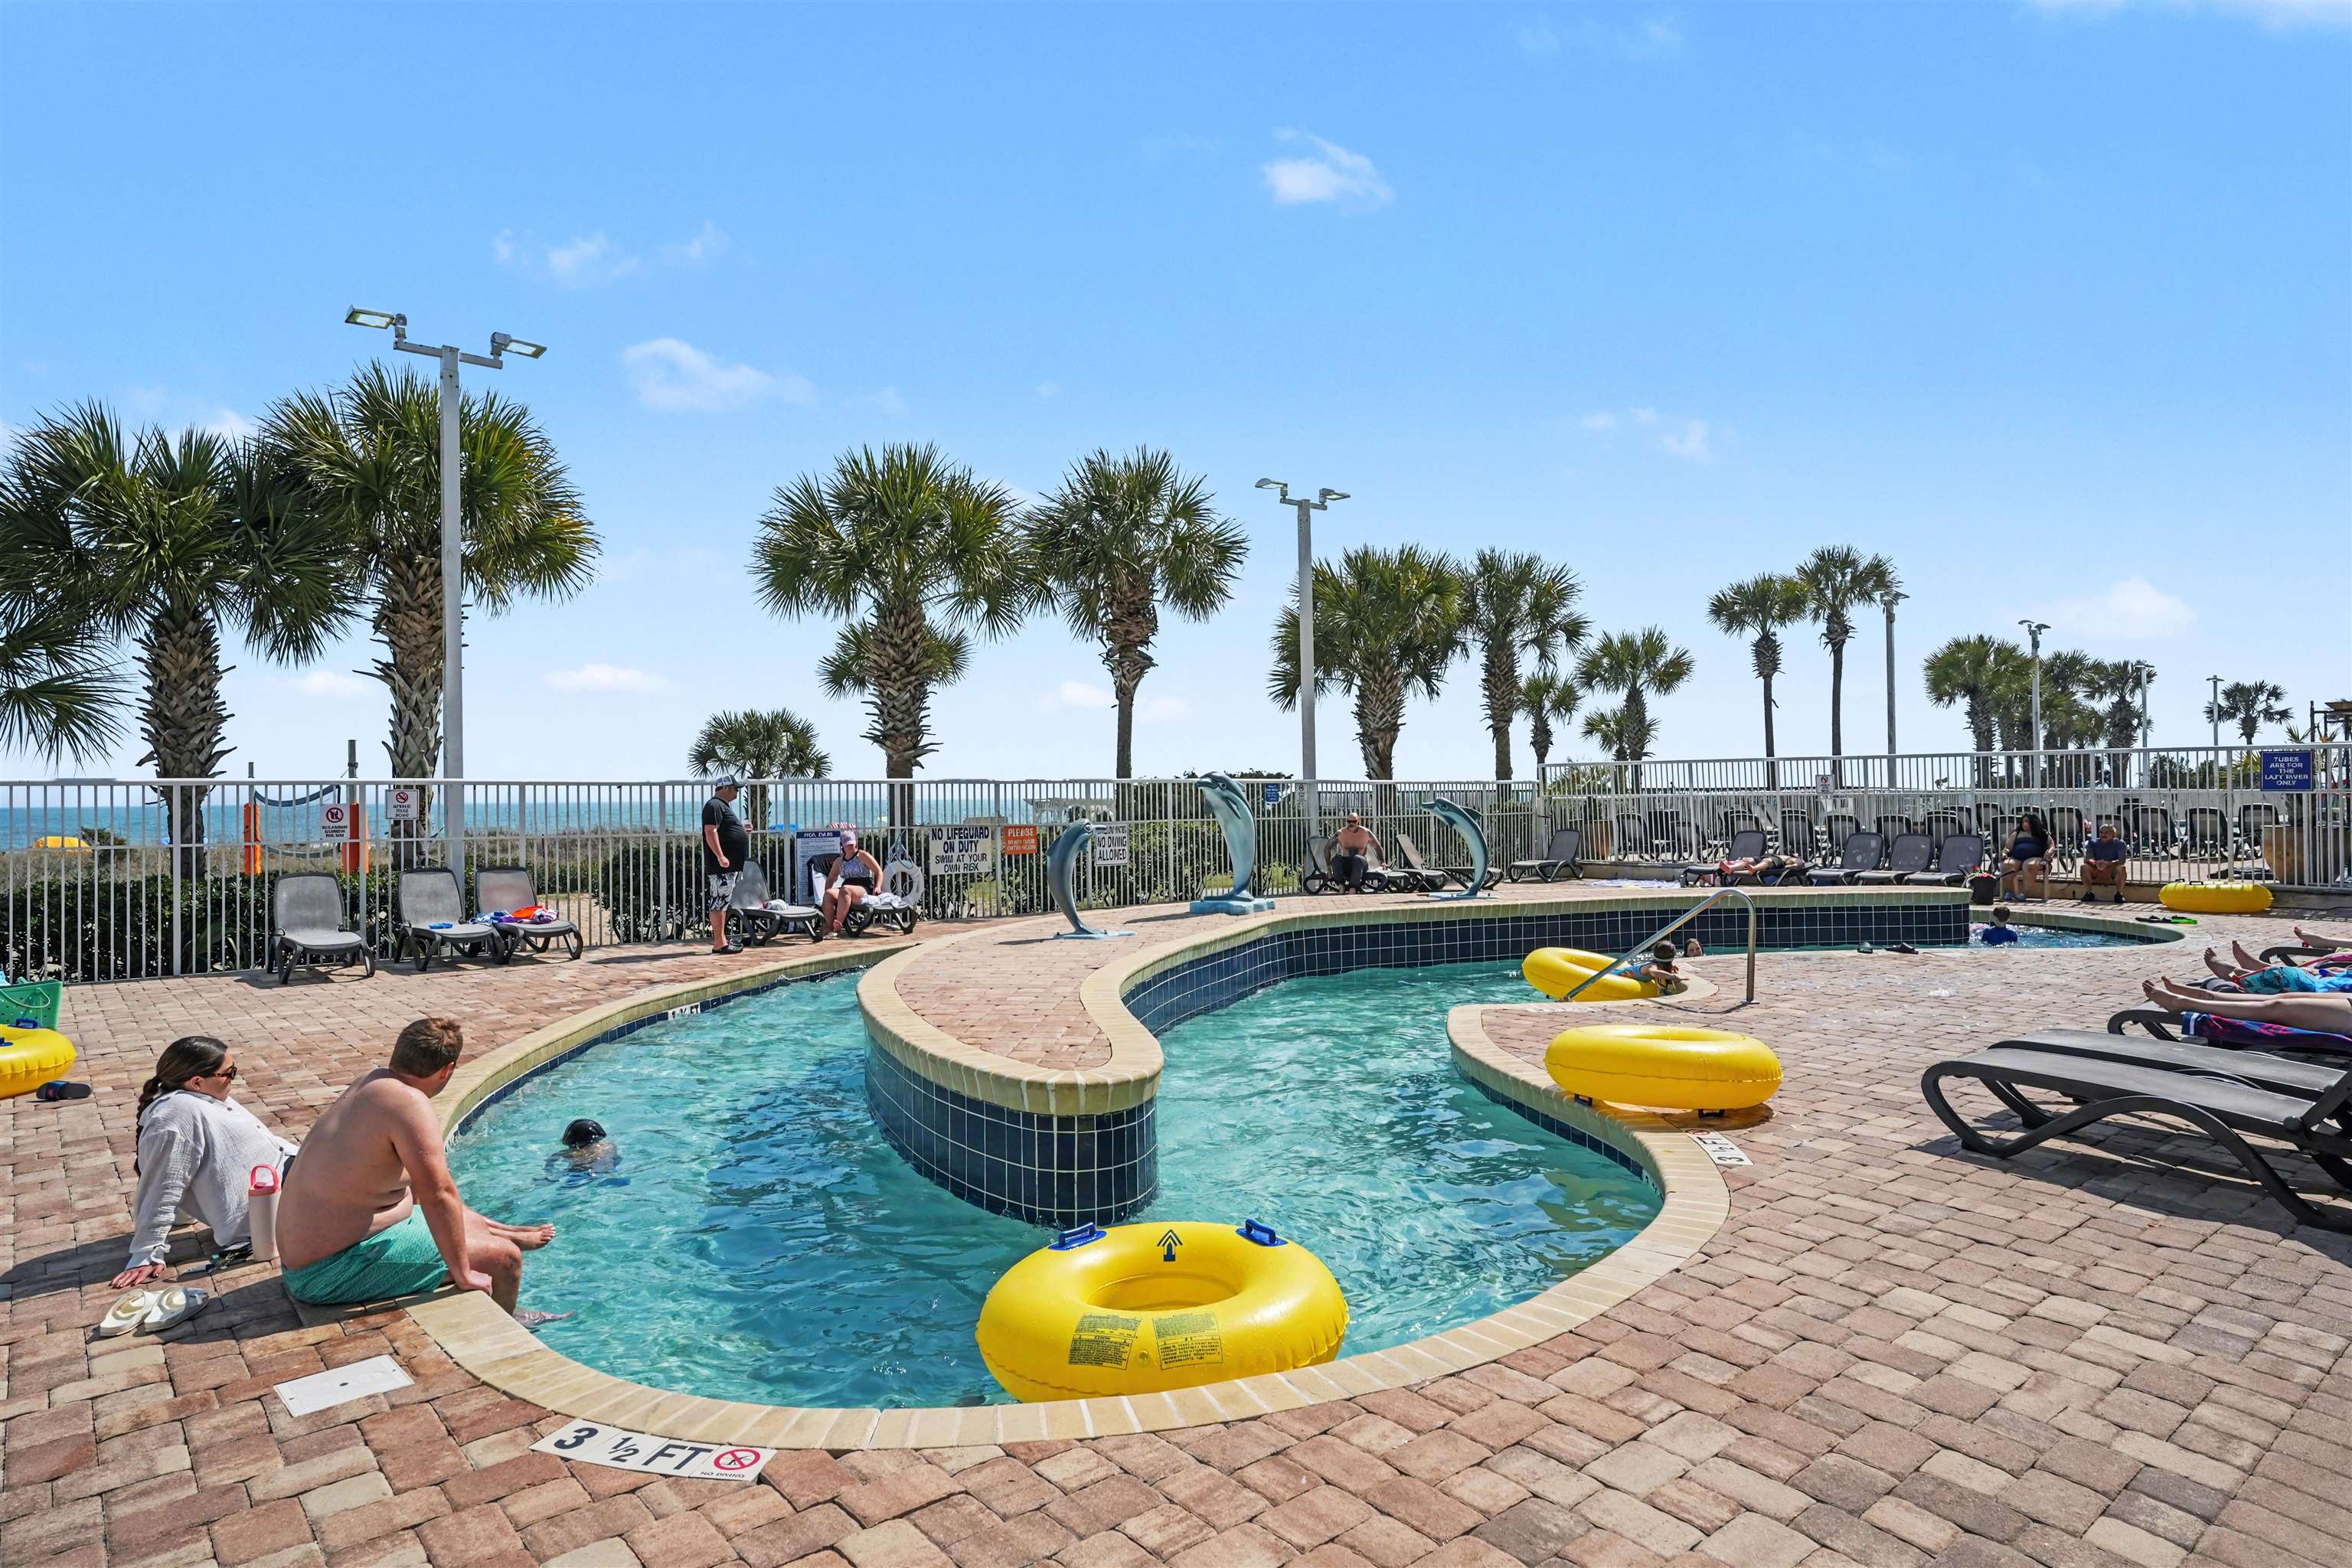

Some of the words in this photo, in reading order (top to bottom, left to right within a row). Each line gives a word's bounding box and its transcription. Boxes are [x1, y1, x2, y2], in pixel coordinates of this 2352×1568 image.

[932, 828, 943, 841] NO
[947, 827, 989, 840] LIFEGUARD
[1008, 828, 1034, 837] PLEASE
[943, 841, 955, 854] ON
[959, 840, 978, 853] DUTY
[1097, 836, 1106, 848] NO
[1107, 836, 1127, 848] DIVING
[935, 854, 953, 864] SWIM
[969, 853, 987, 862] YOUR
[1097, 848, 1127, 861] ALLOWED
[944, 864, 961, 873] OWN
[963, 863, 979, 872] RISK
[554, 1427, 599, 1450] 3
[642, 1443, 714, 1471] FT
